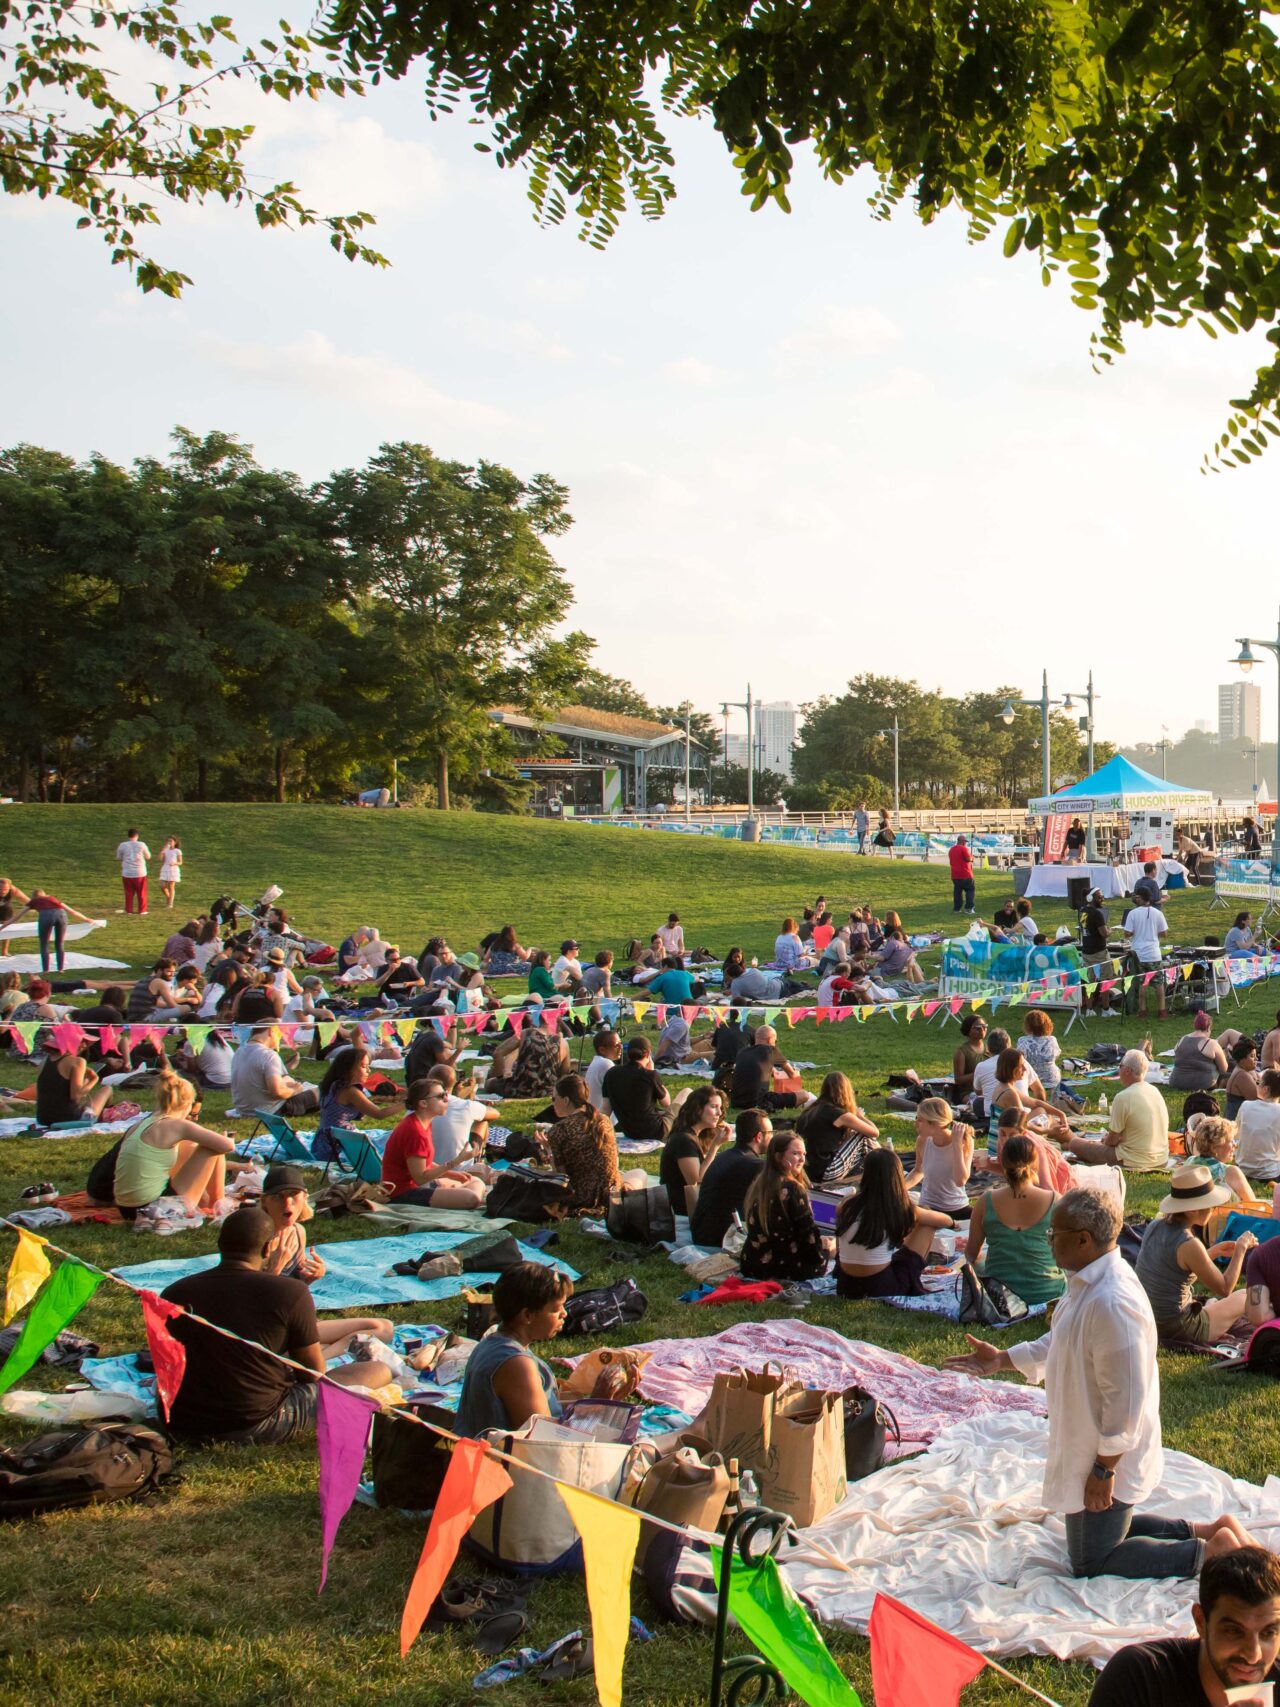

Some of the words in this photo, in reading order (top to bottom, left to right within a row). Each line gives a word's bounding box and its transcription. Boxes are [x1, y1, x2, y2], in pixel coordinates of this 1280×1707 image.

[1057, 803, 1069, 811] CITY
[1070, 802, 1091, 810] WINERY
[1125, 795, 1167, 809] HUDSON
[1169, 794, 1195, 806] RIVER
[1052, 832, 1060, 850] CITY
[950, 957, 970, 972] Play
[948, 979, 1005, 997] HUDSON
